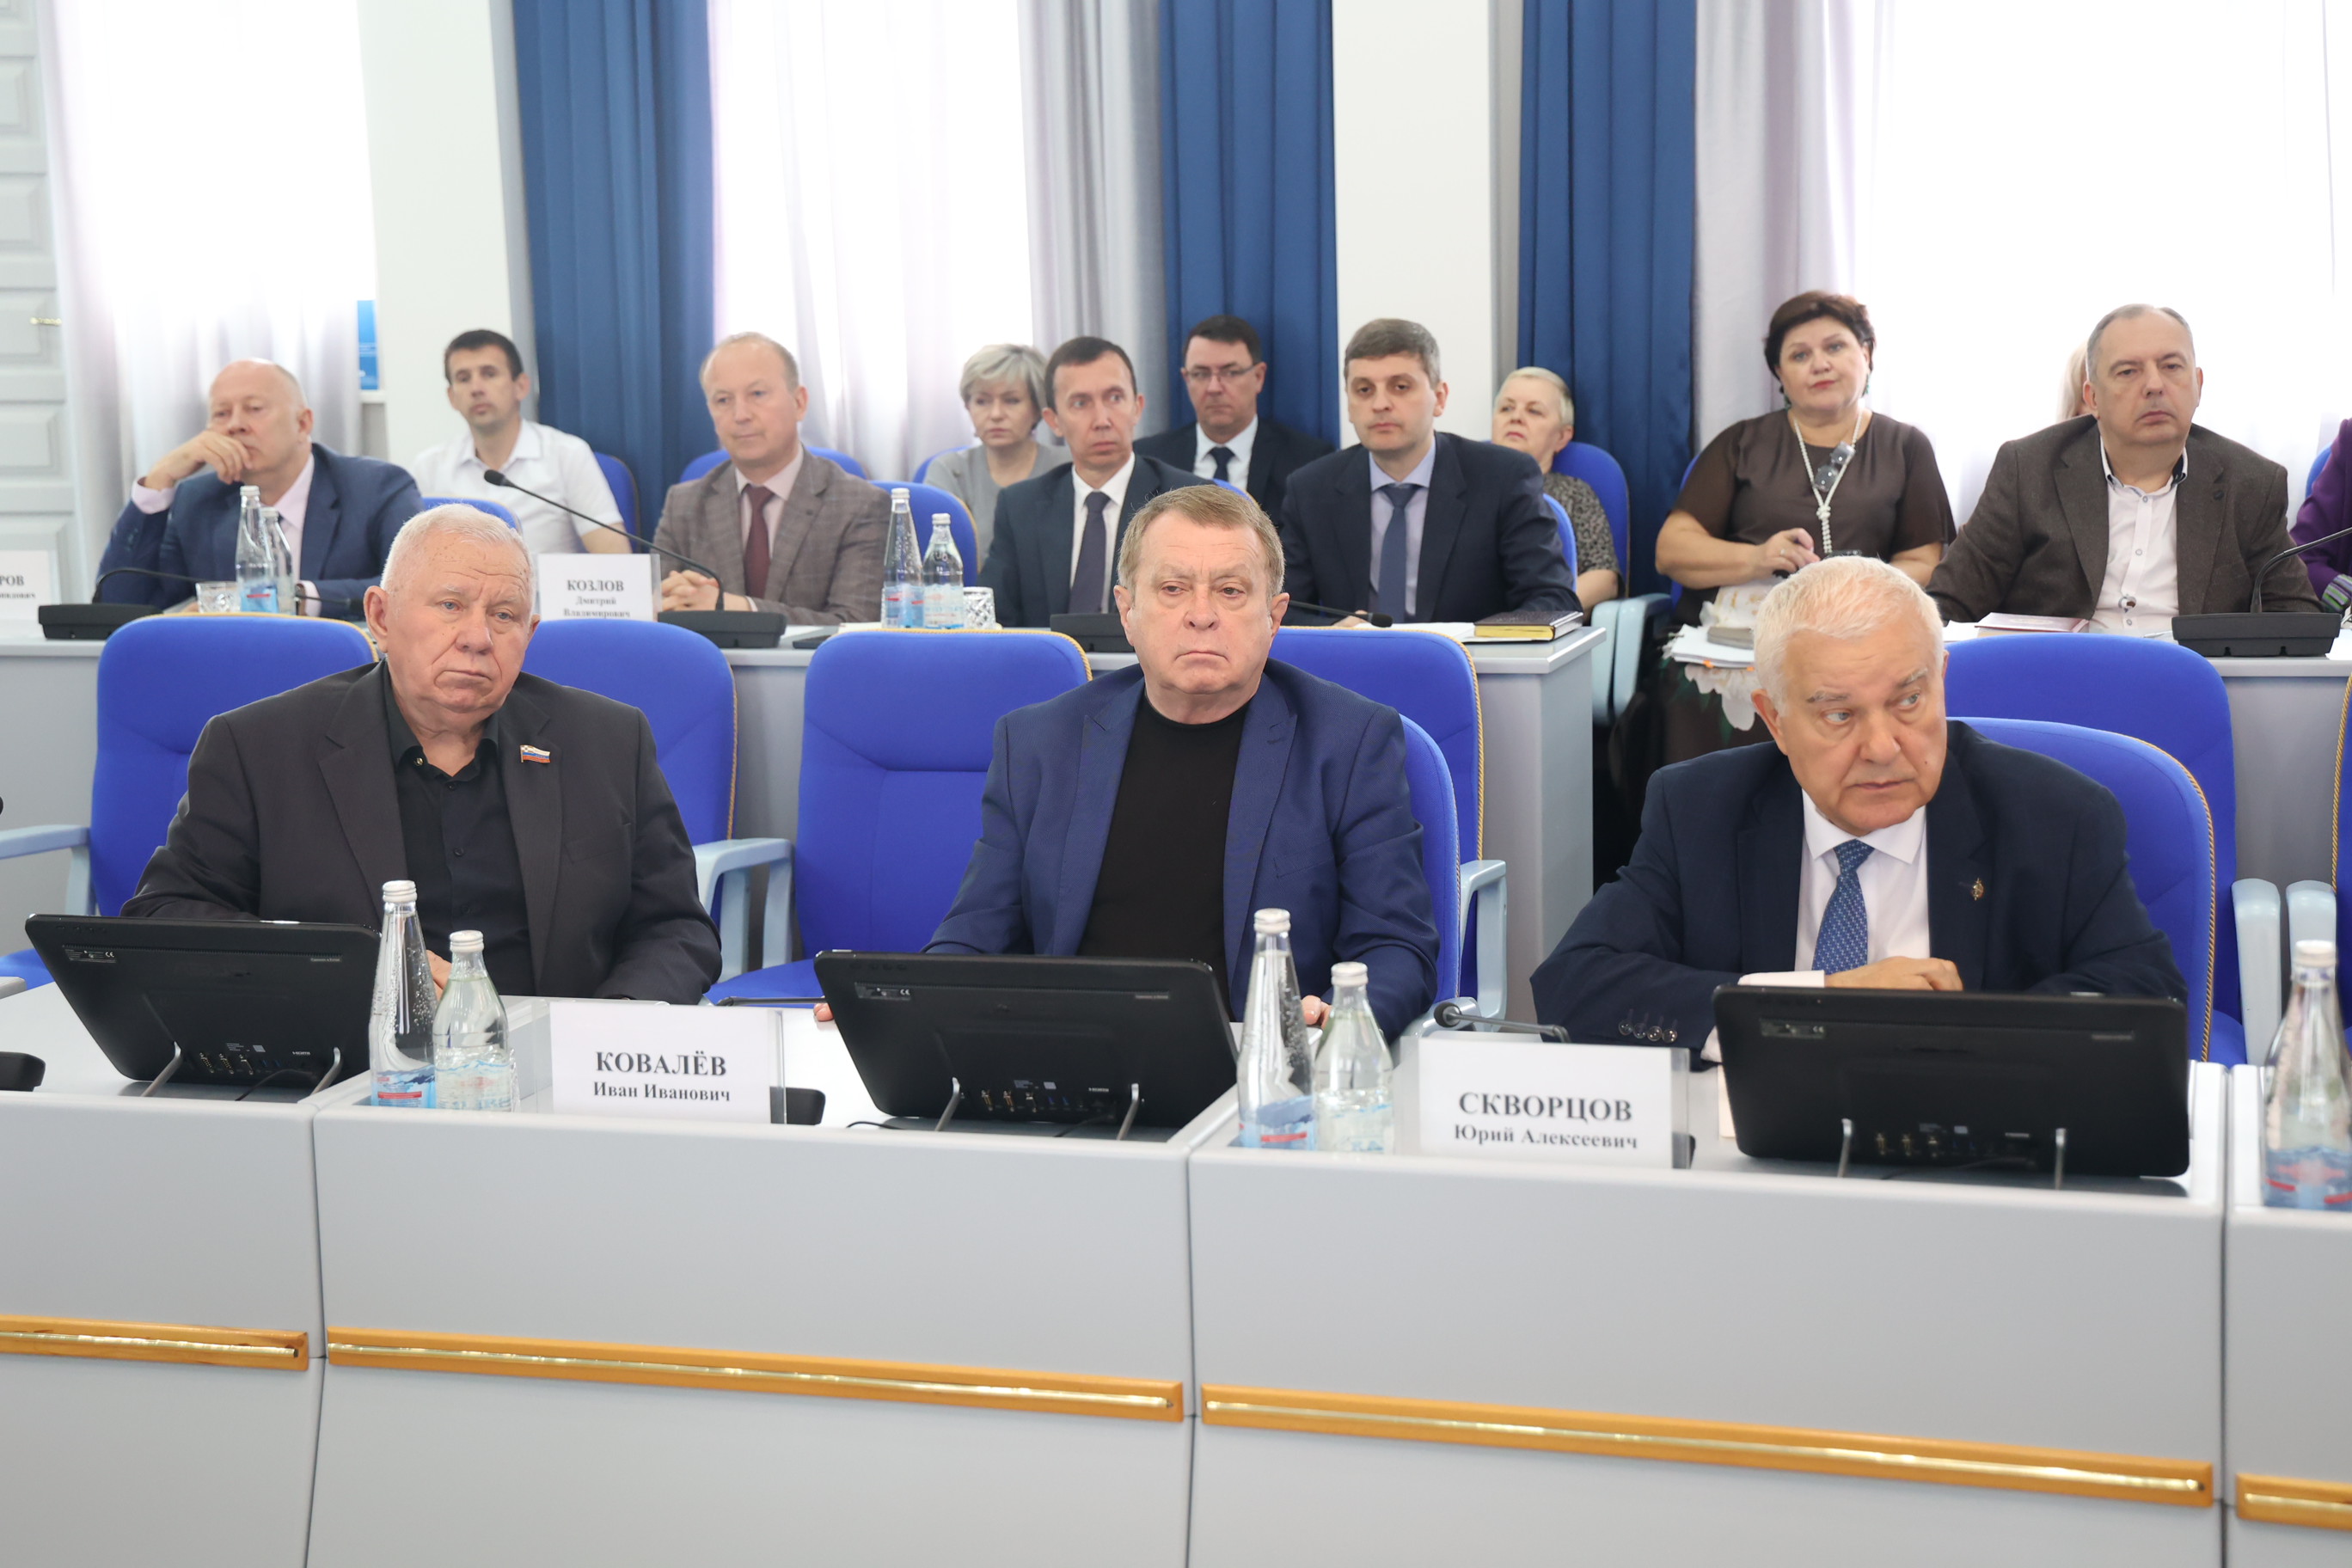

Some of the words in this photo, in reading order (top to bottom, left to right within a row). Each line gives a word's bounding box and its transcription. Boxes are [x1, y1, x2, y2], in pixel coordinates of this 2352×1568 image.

[567, 579, 625, 592] КОЗЛОВ
[576, 595, 616, 607] Дмитрий
[563, 608, 630, 619] Владимирович
[596, 1050, 727, 1076] КОВАЛЁВ
[593, 1081, 638, 1098] Иван
[644, 1082, 731, 1101] Иванович
[1458, 1091, 1632, 1124] СКВОРЦОВ
[1454, 1124, 1514, 1145] Юрий
[1521, 1128, 1638, 1149] Алексеевич
